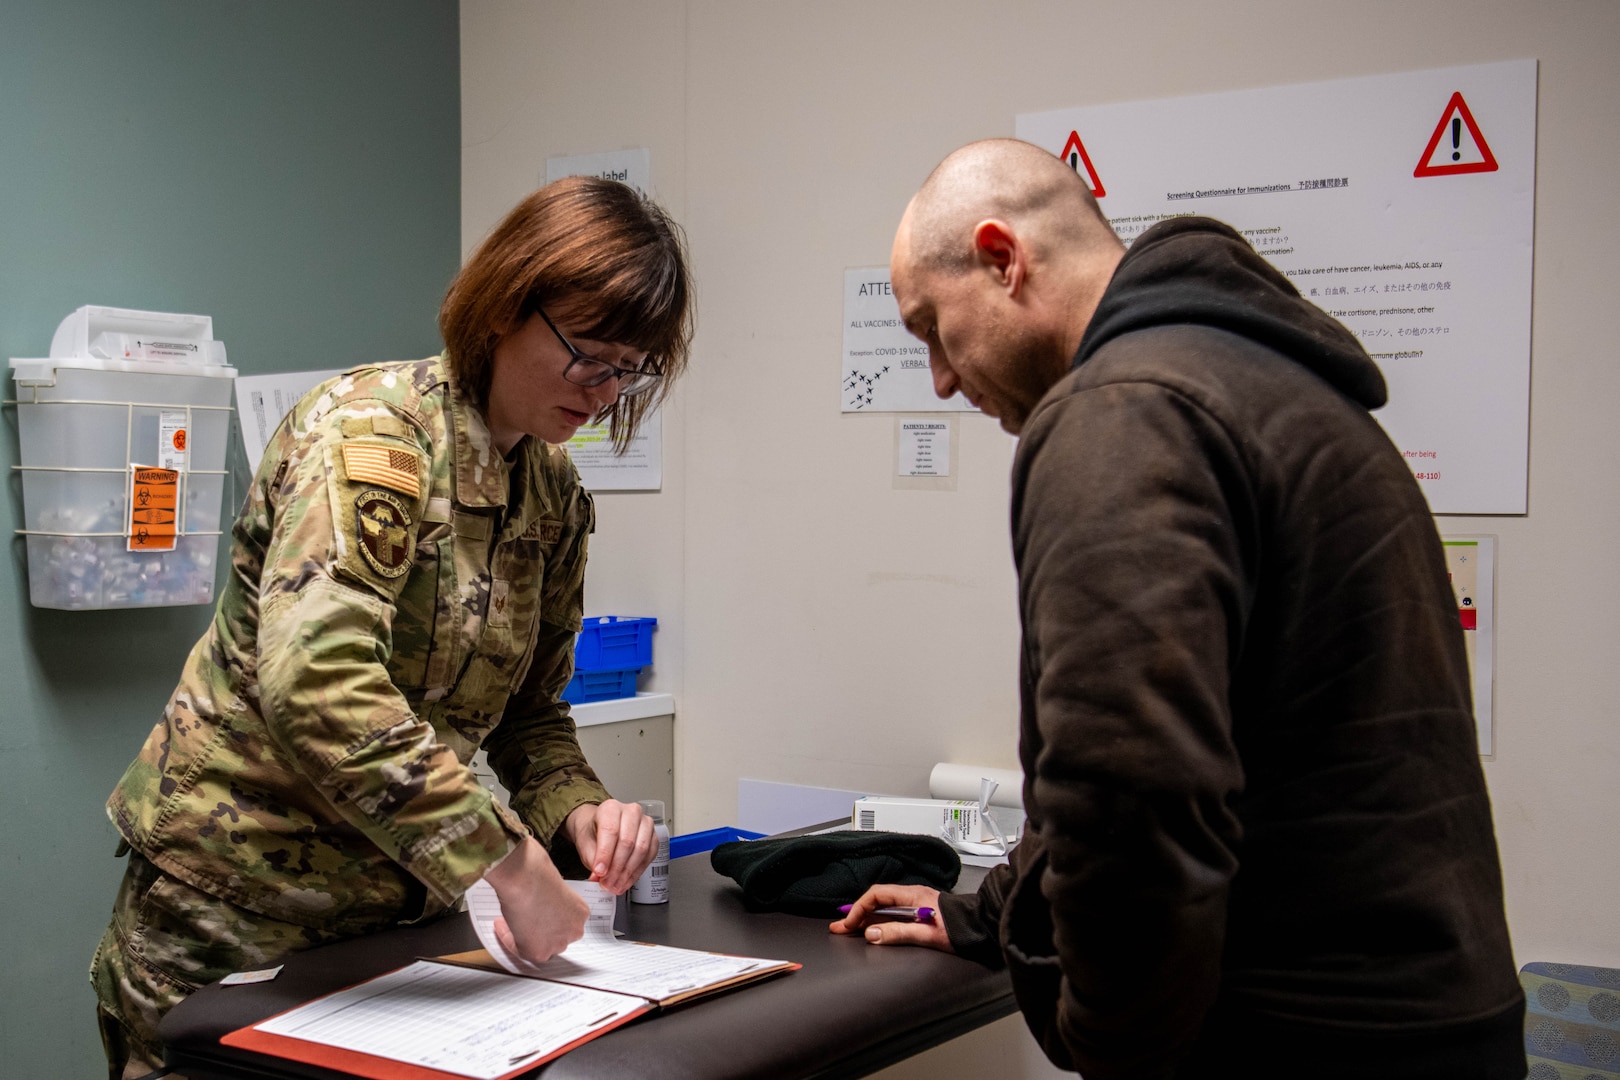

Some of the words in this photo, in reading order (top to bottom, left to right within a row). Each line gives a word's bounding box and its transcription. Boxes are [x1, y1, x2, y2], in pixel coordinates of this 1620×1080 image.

[602, 168, 628, 181] label
[1167, 191, 1195, 200] Screening
[1196, 186, 1236, 198] Questionnaire
[1237, 186, 1246, 194] for
[1247, 183, 1291, 194] Immunizations
[1111, 216, 1131, 224] patient
[1131, 215, 1142, 223] sick
[1143, 214, 1155, 222] with
[1244, 229, 1255, 237] any
[1256, 226, 1281, 235] vaccine?
[1257, 246, 1294, 256] vaccination?
[1286, 269, 1297, 277] you
[1326, 266, 1333, 274] of
[1333, 266, 1349, 274] have
[1350, 265, 1372, 274] cancer,
[1373, 262, 1403, 272] leukemia,
[1405, 261, 1421, 270] AIDS,
[1430, 261, 1443, 269] any
[858, 282, 892, 296] ATTE
[1333, 309, 1347, 317] take
[1347, 308, 1378, 317] cortisone,
[1379, 307, 1416, 318] prednisone,
[1417, 306, 1435, 314] other
[851, 320, 863, 328] ALL
[864, 319, 897, 328] VACCINES
[875, 347, 908, 356] COVID-19
[909, 347, 929, 355] VACC
[1394, 350, 1424, 361] globulin?
[901, 360, 926, 368] VERBAL
[1402, 450, 1418, 458] after
[1418, 450, 1437, 459] being
[138, 472, 175, 481] WARNING
[1416, 472, 1441, 481] 48-110)
